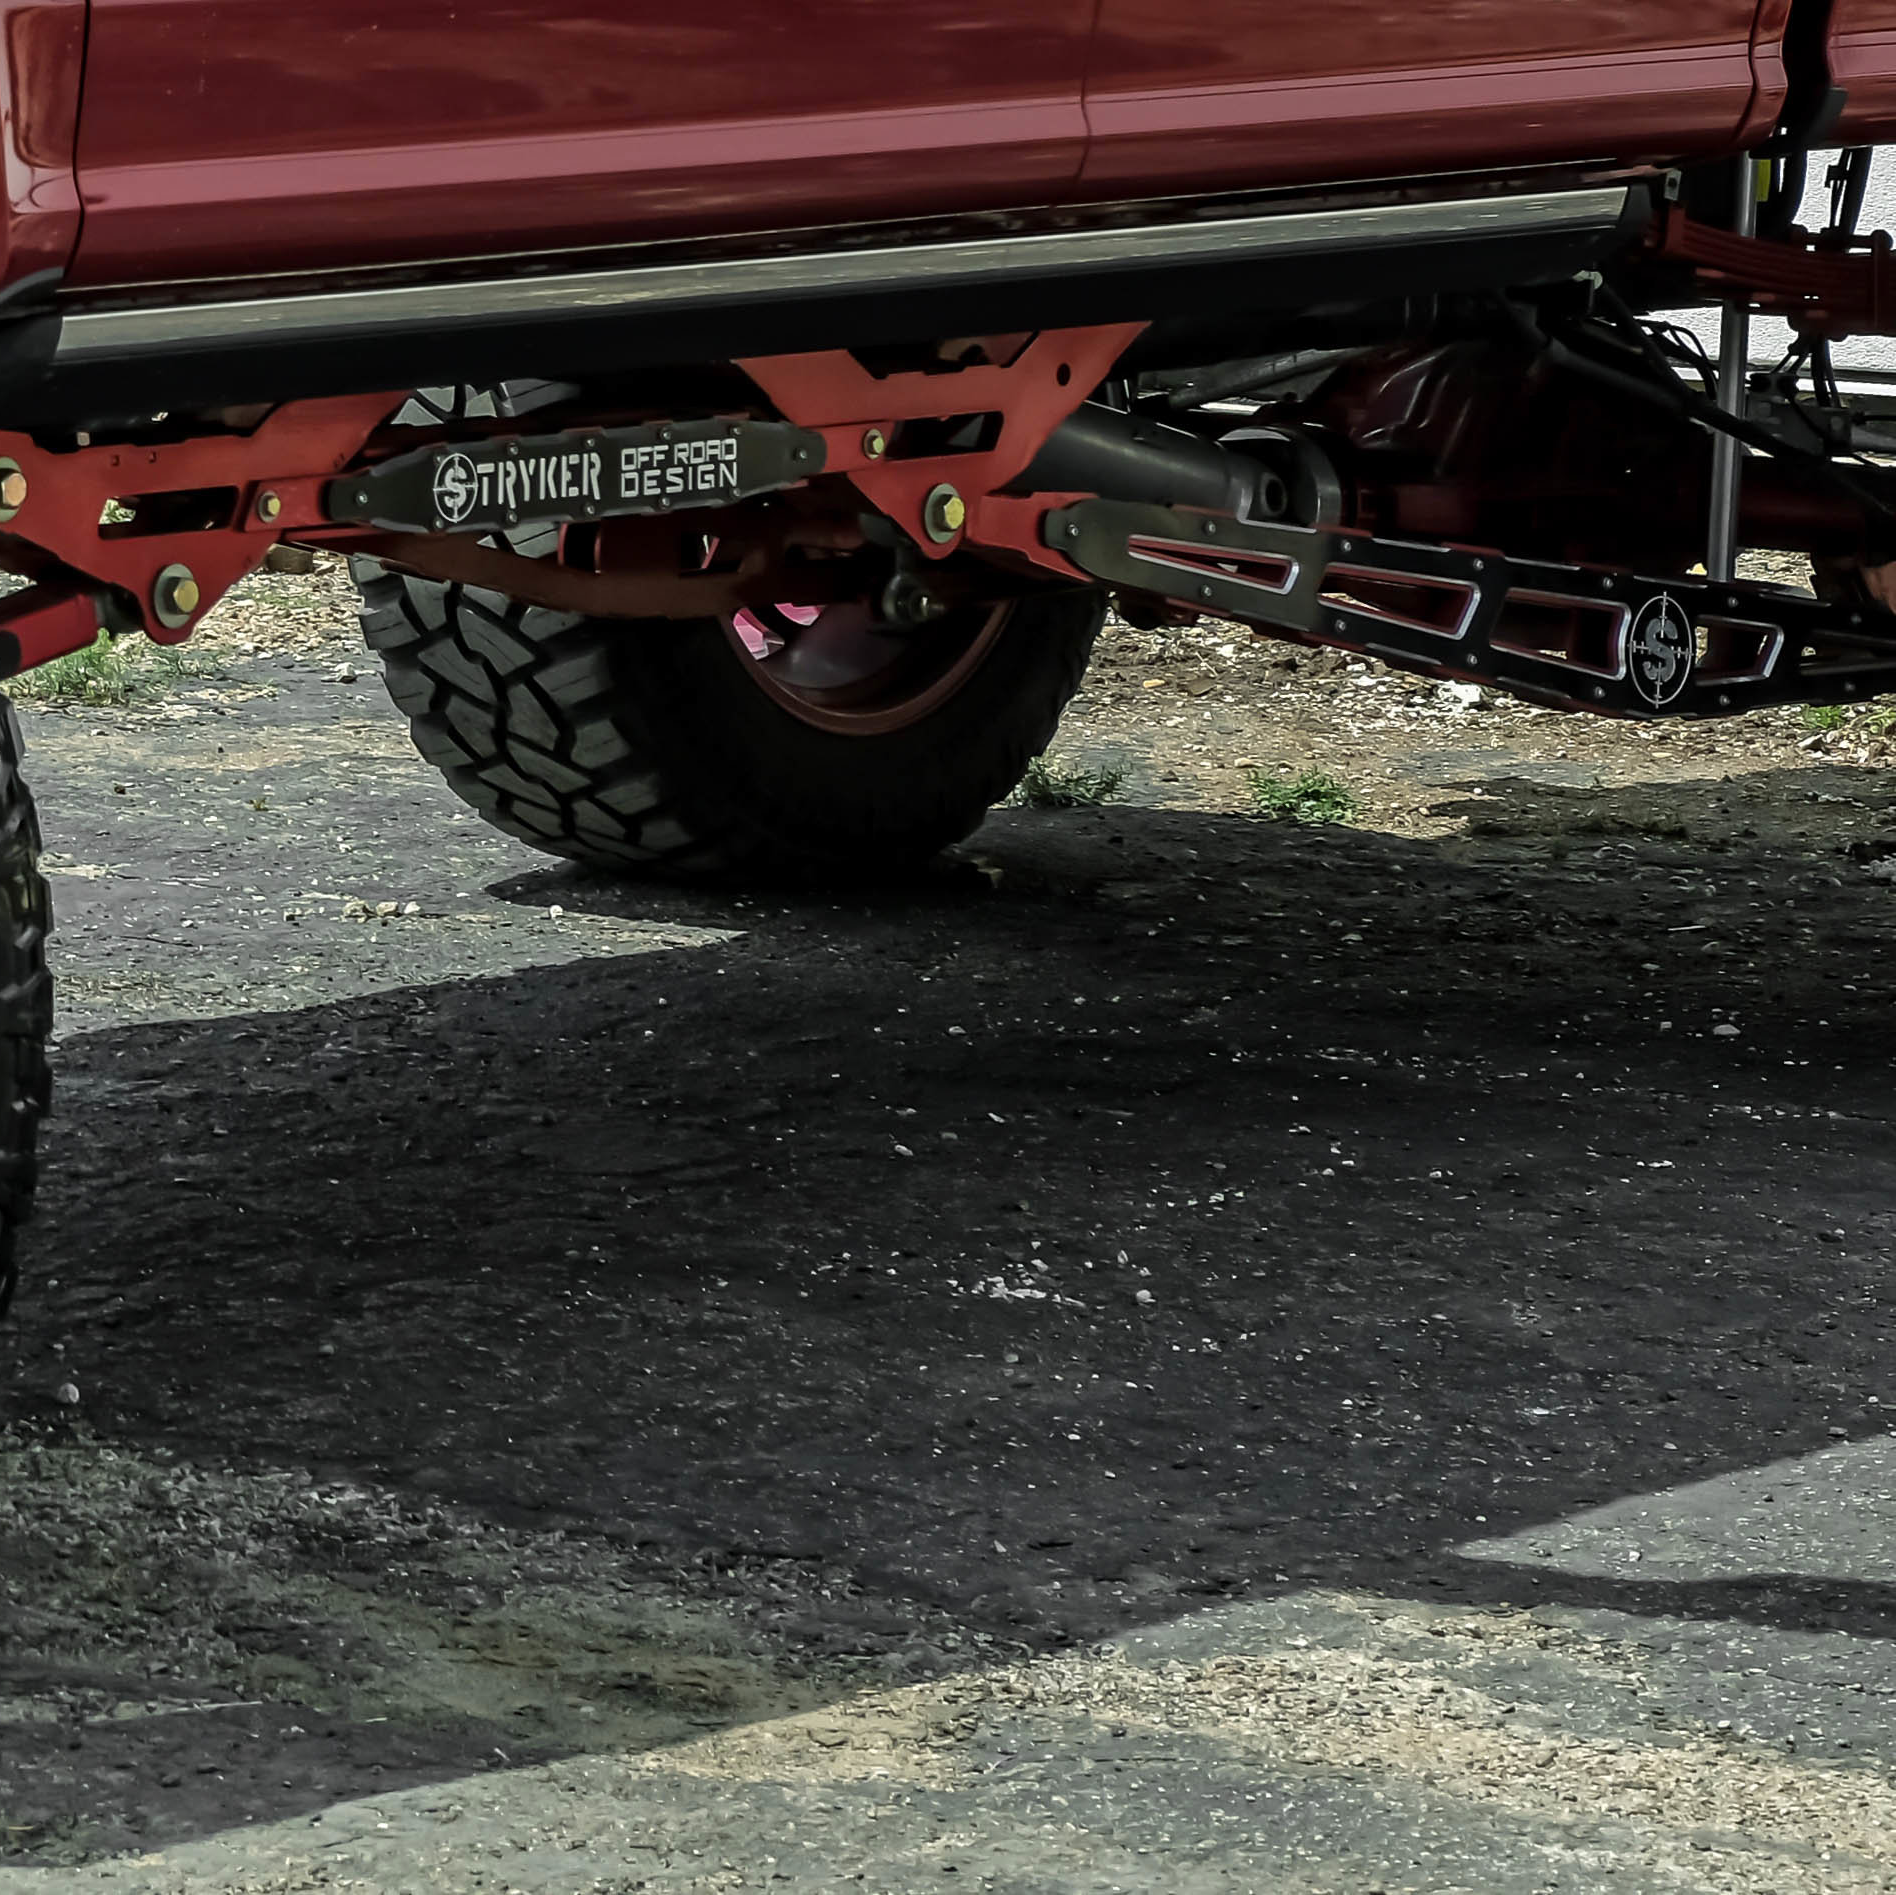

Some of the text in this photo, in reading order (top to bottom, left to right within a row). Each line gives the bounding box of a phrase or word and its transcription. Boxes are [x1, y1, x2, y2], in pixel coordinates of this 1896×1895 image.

[620, 437, 738, 472] OFF ROAD
[441, 452, 603, 510] STRYKER
[620, 461, 738, 499] DESIGN
